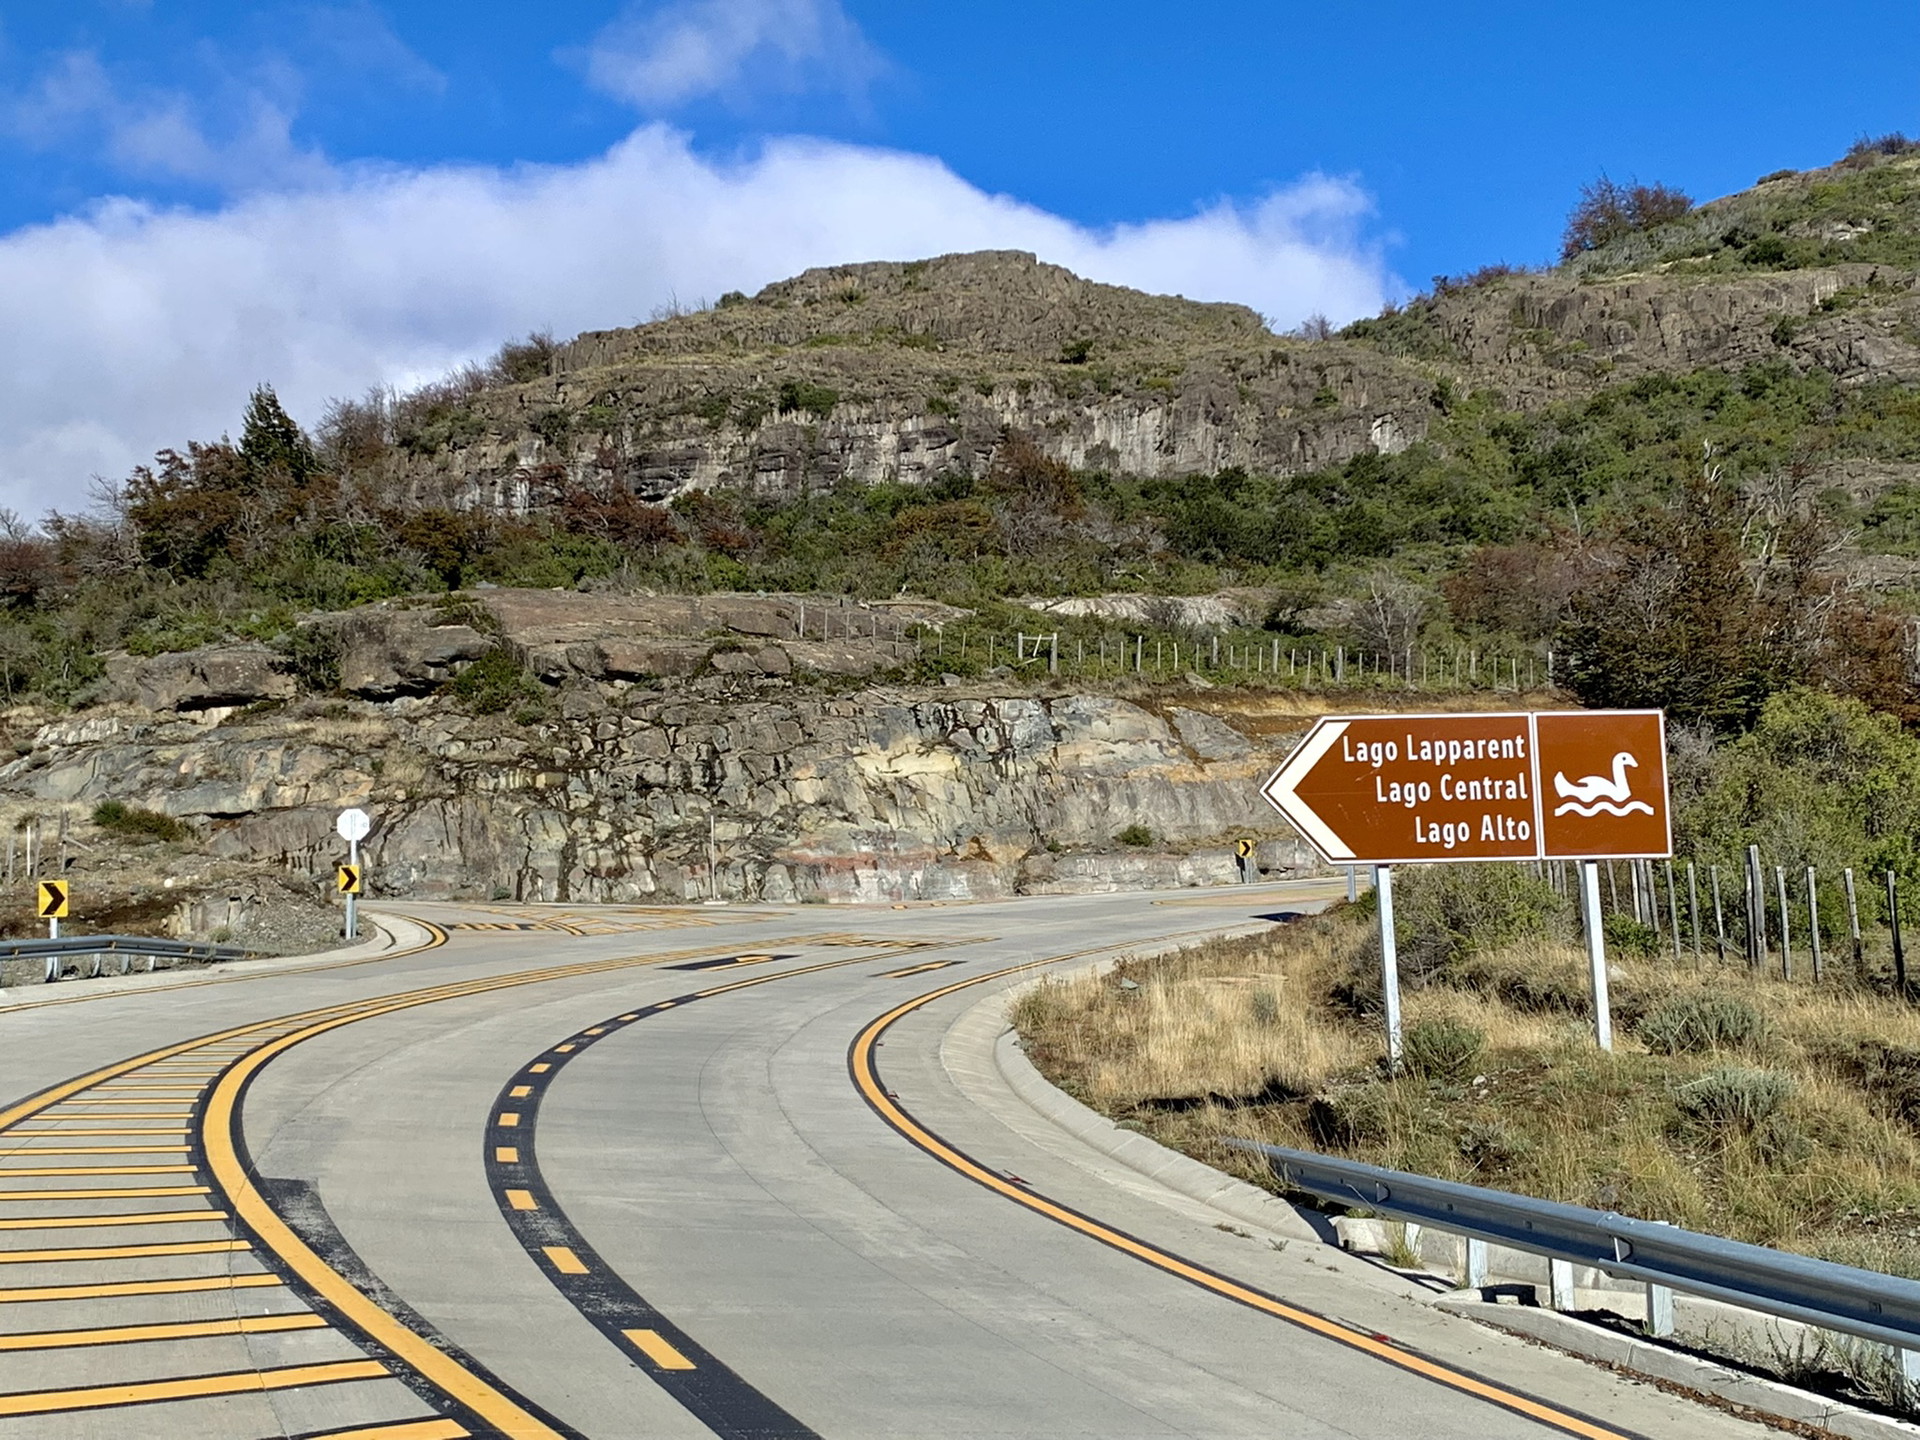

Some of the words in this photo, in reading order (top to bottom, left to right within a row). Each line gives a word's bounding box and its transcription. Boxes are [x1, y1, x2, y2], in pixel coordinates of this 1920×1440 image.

[1343, 735, 1398, 767] Lago
[1406, 734, 1525, 765] Lapparent
[1376, 775, 1431, 808] Lago
[1440, 773, 1528, 801] Central
[1415, 816, 1470, 848] Lago
[1480, 814, 1531, 842] Alto
